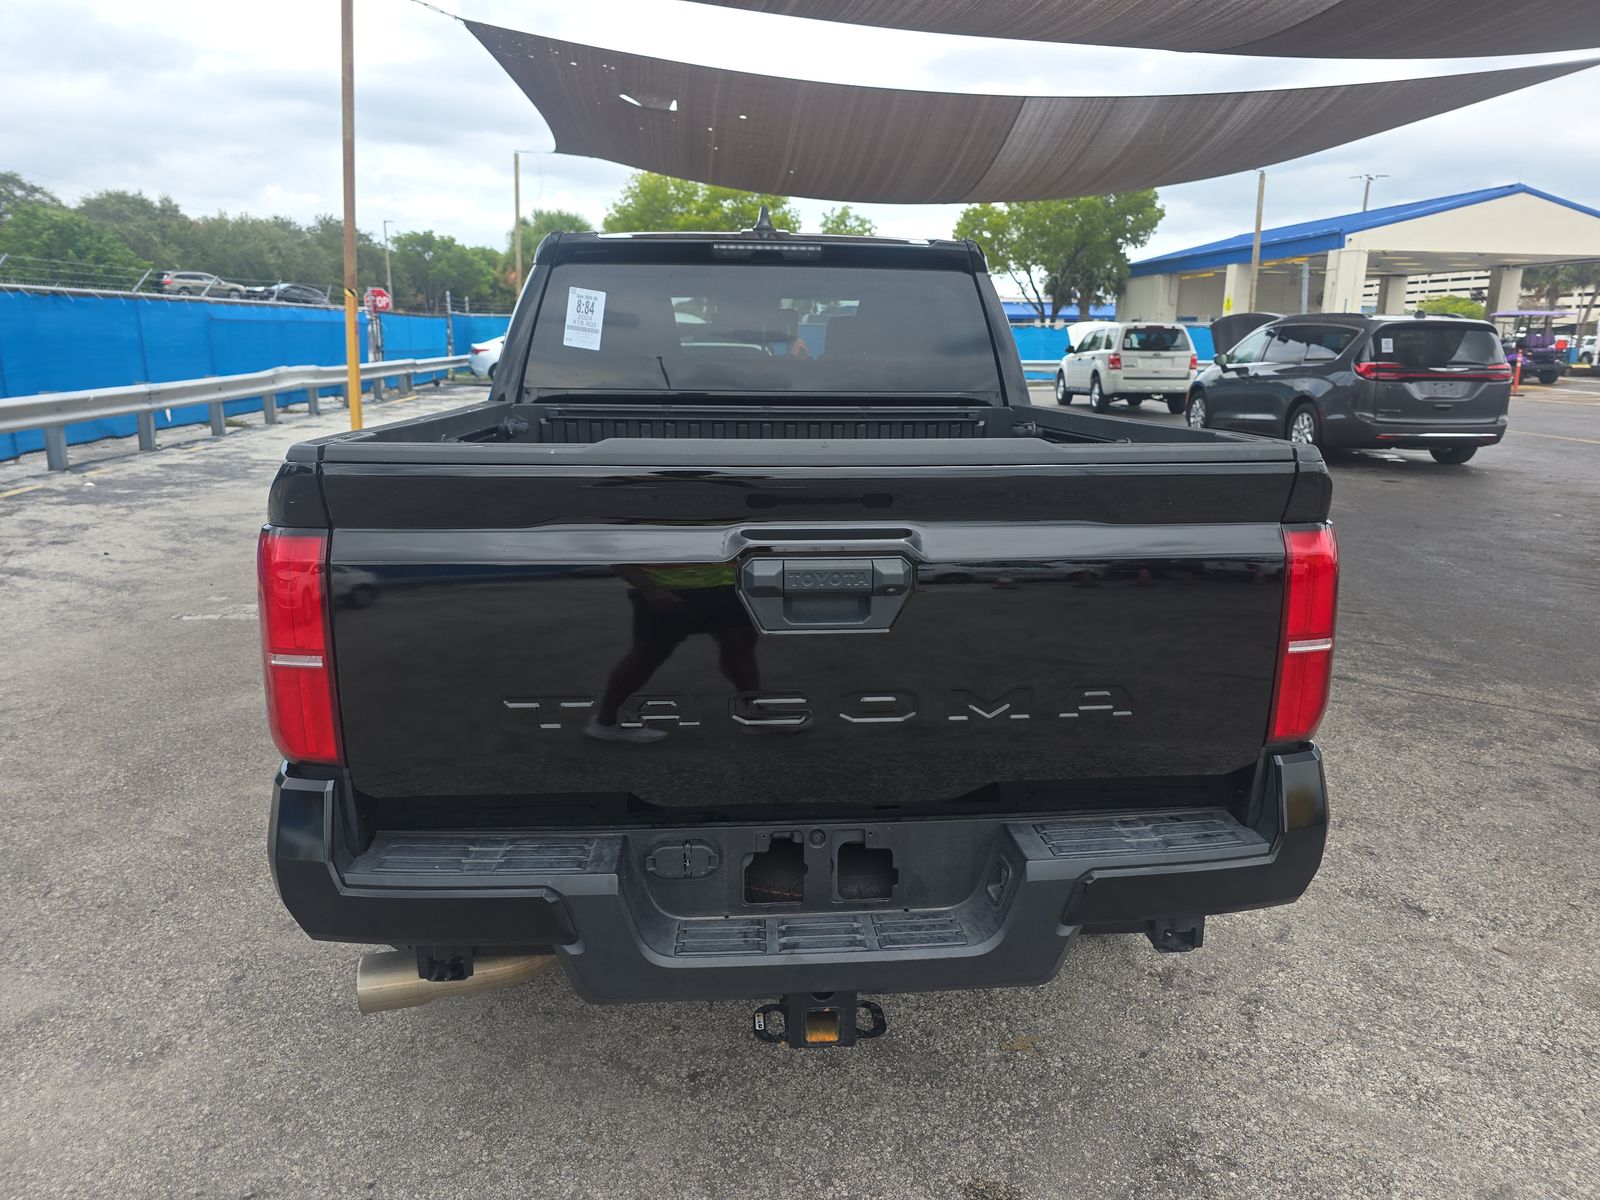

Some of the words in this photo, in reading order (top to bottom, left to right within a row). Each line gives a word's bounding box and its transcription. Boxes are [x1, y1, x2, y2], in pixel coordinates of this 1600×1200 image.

[367, 295, 389, 307] OP
[576, 299, 594, 315] 8:84
[788, 571, 869, 587] TOYOTA
[502, 685, 1136, 729] TACOMA
